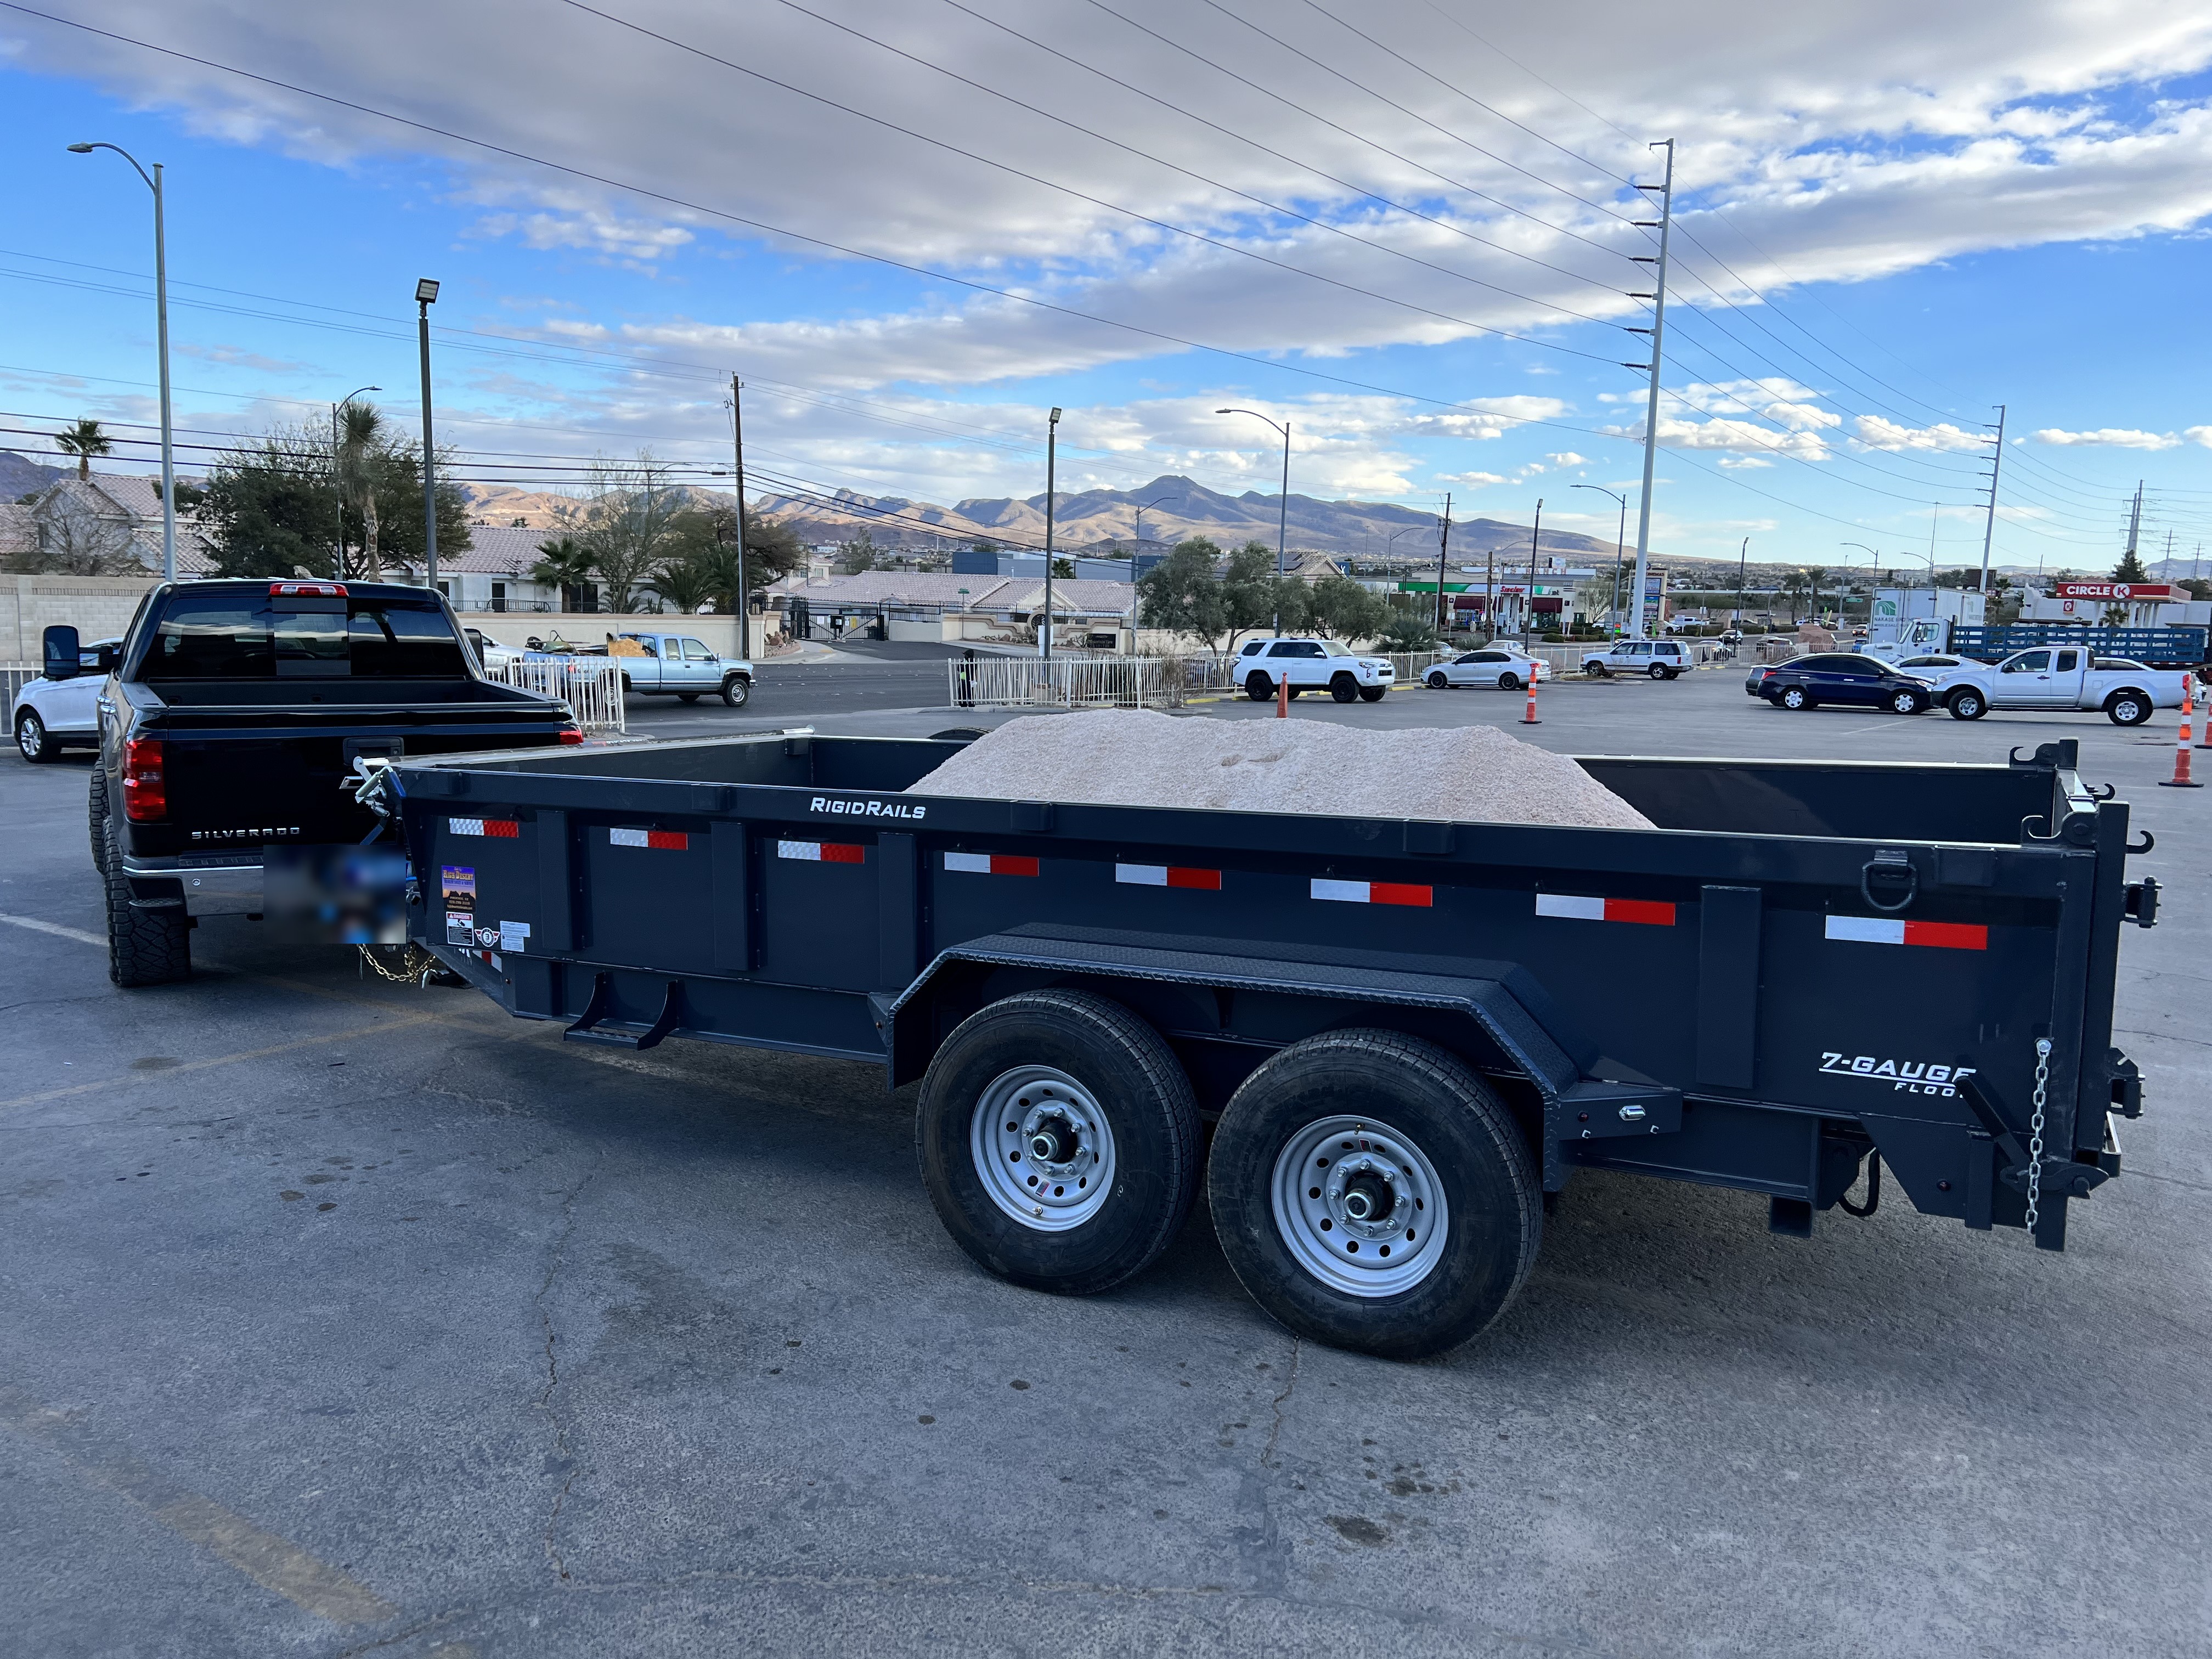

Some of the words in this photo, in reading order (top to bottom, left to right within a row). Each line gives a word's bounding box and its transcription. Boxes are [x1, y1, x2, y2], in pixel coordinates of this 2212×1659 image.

[2066, 585, 2111, 596] CIRCLE
[2117, 586, 2129, 597] K
[810, 797, 927, 819] RIGIDRAILS
[191, 827, 300, 839] SILVERADO
[456, 871, 473, 881] DESERT
[1821, 1052, 1977, 1083] 7-GAUGE
[1894, 1082, 1963, 1098] FLOO
